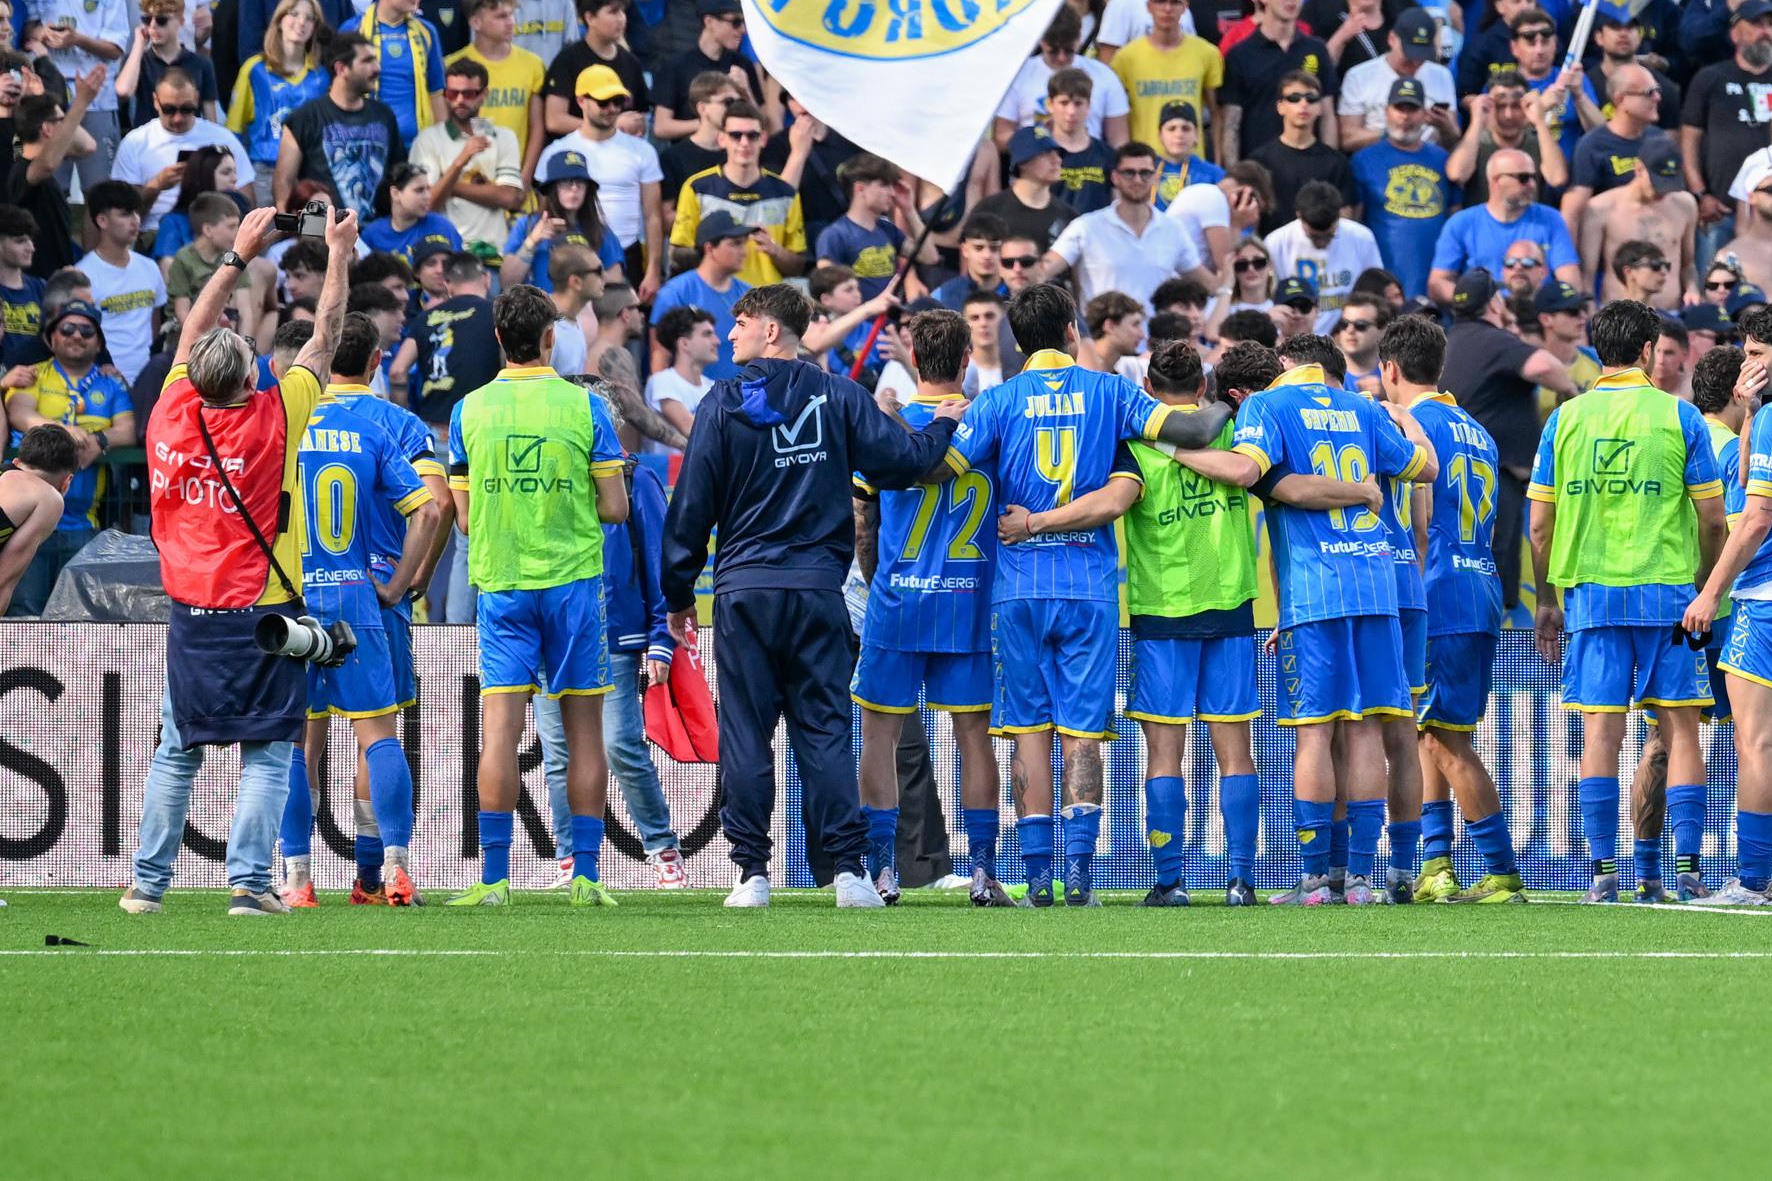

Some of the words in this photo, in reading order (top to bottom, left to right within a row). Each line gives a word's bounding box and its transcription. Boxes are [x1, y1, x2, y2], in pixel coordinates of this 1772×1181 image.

[1024, 392, 1085, 419] JULIAN
[774, 451, 827, 468] GIVOVA
[1034, 426, 1077, 509] 4
[151, 467, 241, 514] PHOTO
[484, 477, 573, 494] GIVOVA
[1566, 479, 1661, 496] GIVOVA
[1158, 495, 1245, 527] GIVOVA
